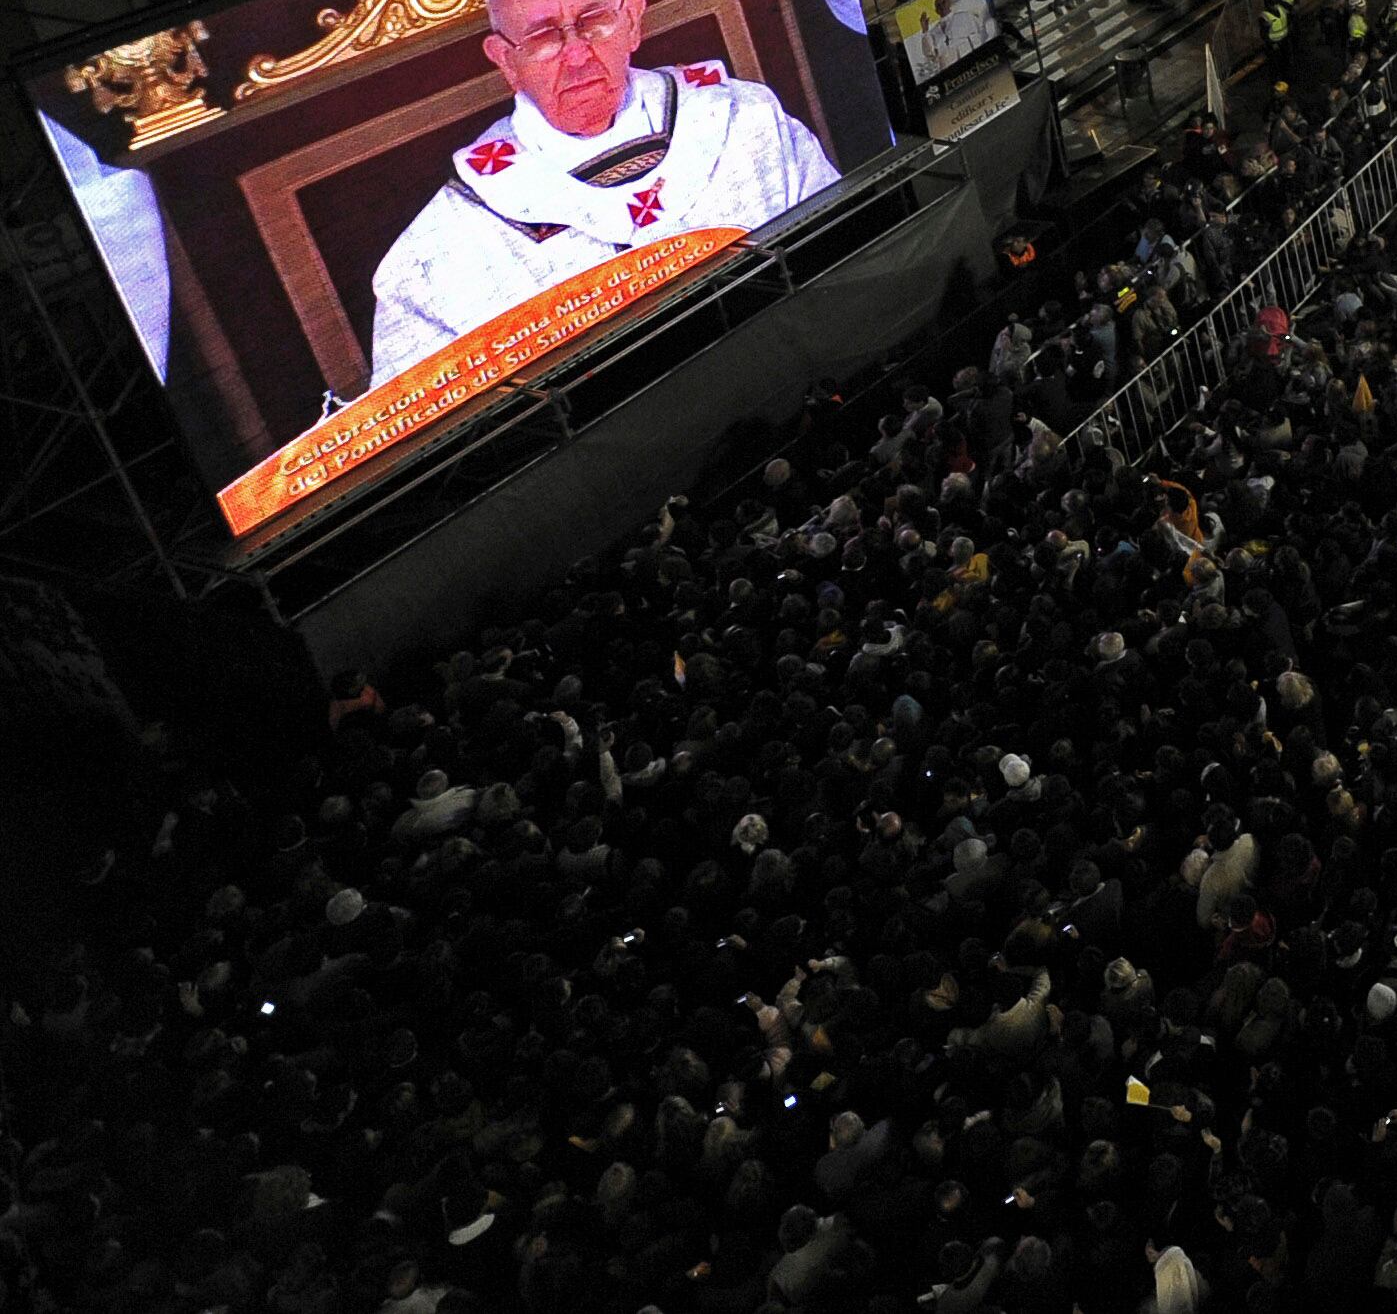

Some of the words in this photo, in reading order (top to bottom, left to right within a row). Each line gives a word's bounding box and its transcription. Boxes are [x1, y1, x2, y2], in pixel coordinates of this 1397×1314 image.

[943, 53, 999, 95] Francisco
[288, 464, 329, 496] del
[334, 387, 468, 468] Pontificado
[472, 365, 501, 387] de
[504, 346, 531, 367] Su
[535, 289, 624, 350] Santidad
[628, 240, 715, 296] Francisco
[431, 368, 462, 389] de
[465, 353, 488, 370] la
[491, 315, 551, 355] Santa
[554, 286, 603, 319] Misa
[607, 268, 633, 288] de
[636, 237, 688, 271] Inicio
